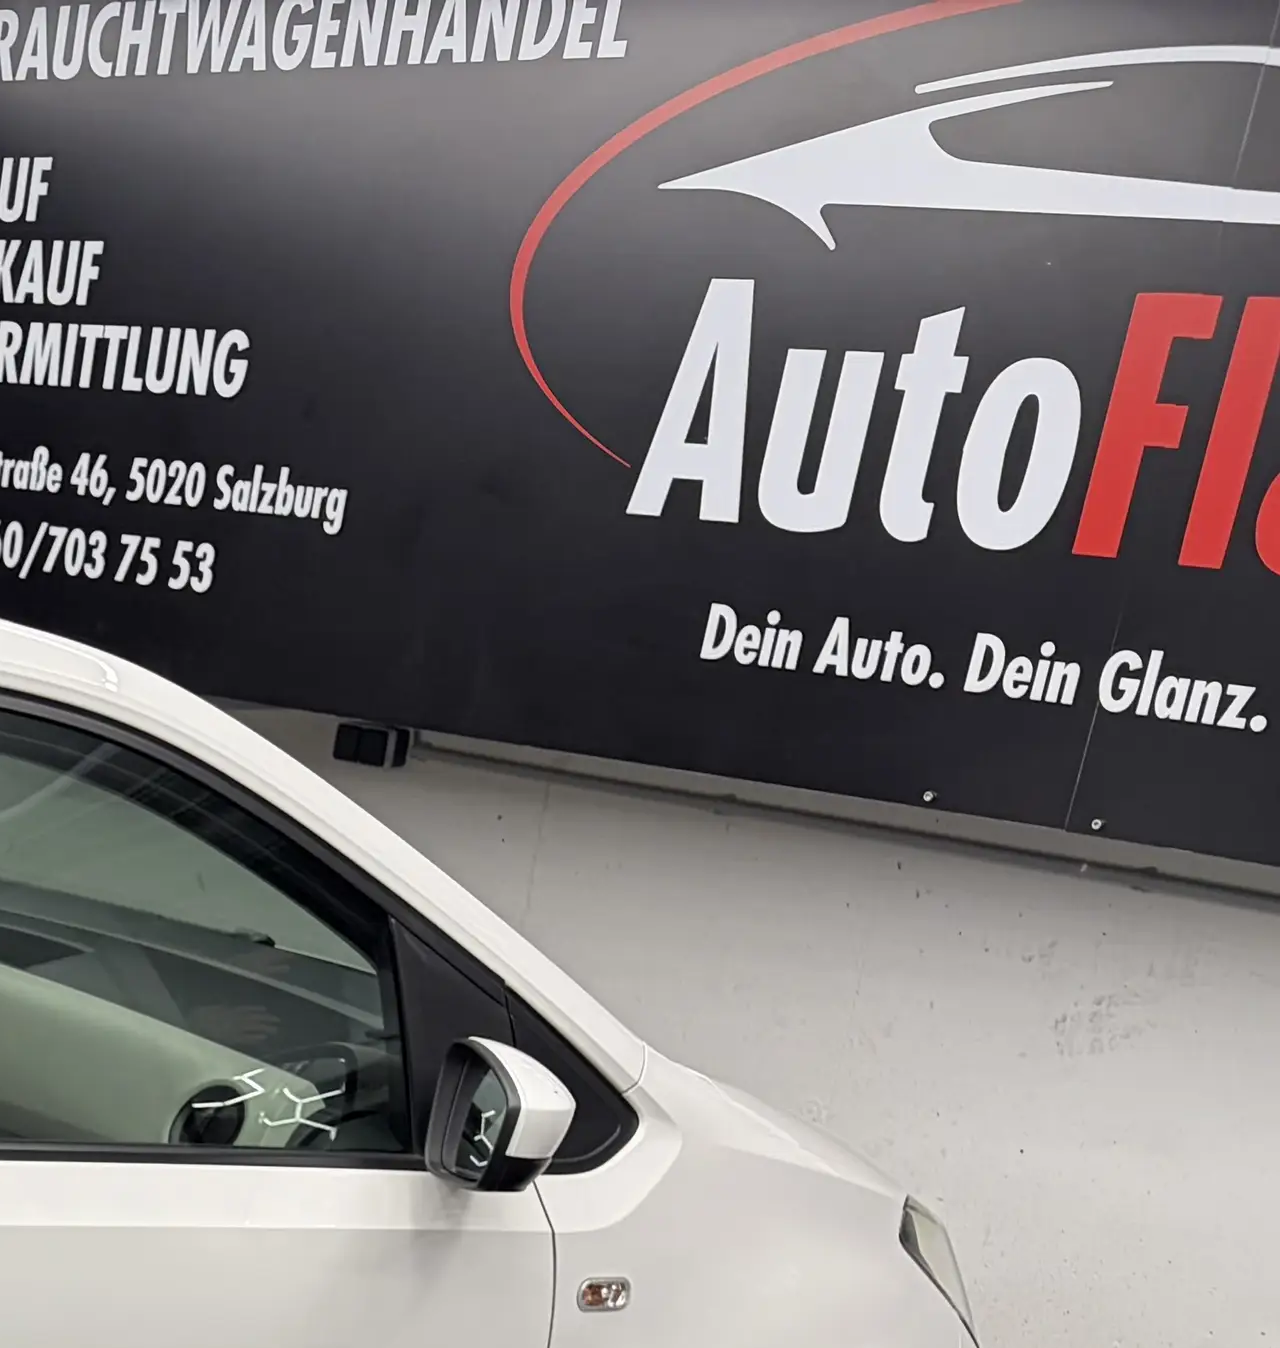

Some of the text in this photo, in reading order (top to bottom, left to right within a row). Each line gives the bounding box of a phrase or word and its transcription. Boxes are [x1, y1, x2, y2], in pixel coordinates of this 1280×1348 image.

[626, 278, 1280, 577] AutoFl
[71, 452, 117, 506] 46,
[126, 458, 206, 507] 5020
[214, 464, 348, 535] Salzburg
[115, 534, 161, 586] 75
[168, 540, 215, 593] 53
[699, 602, 1268, 733] Dein Auto. Dein Glanz.
